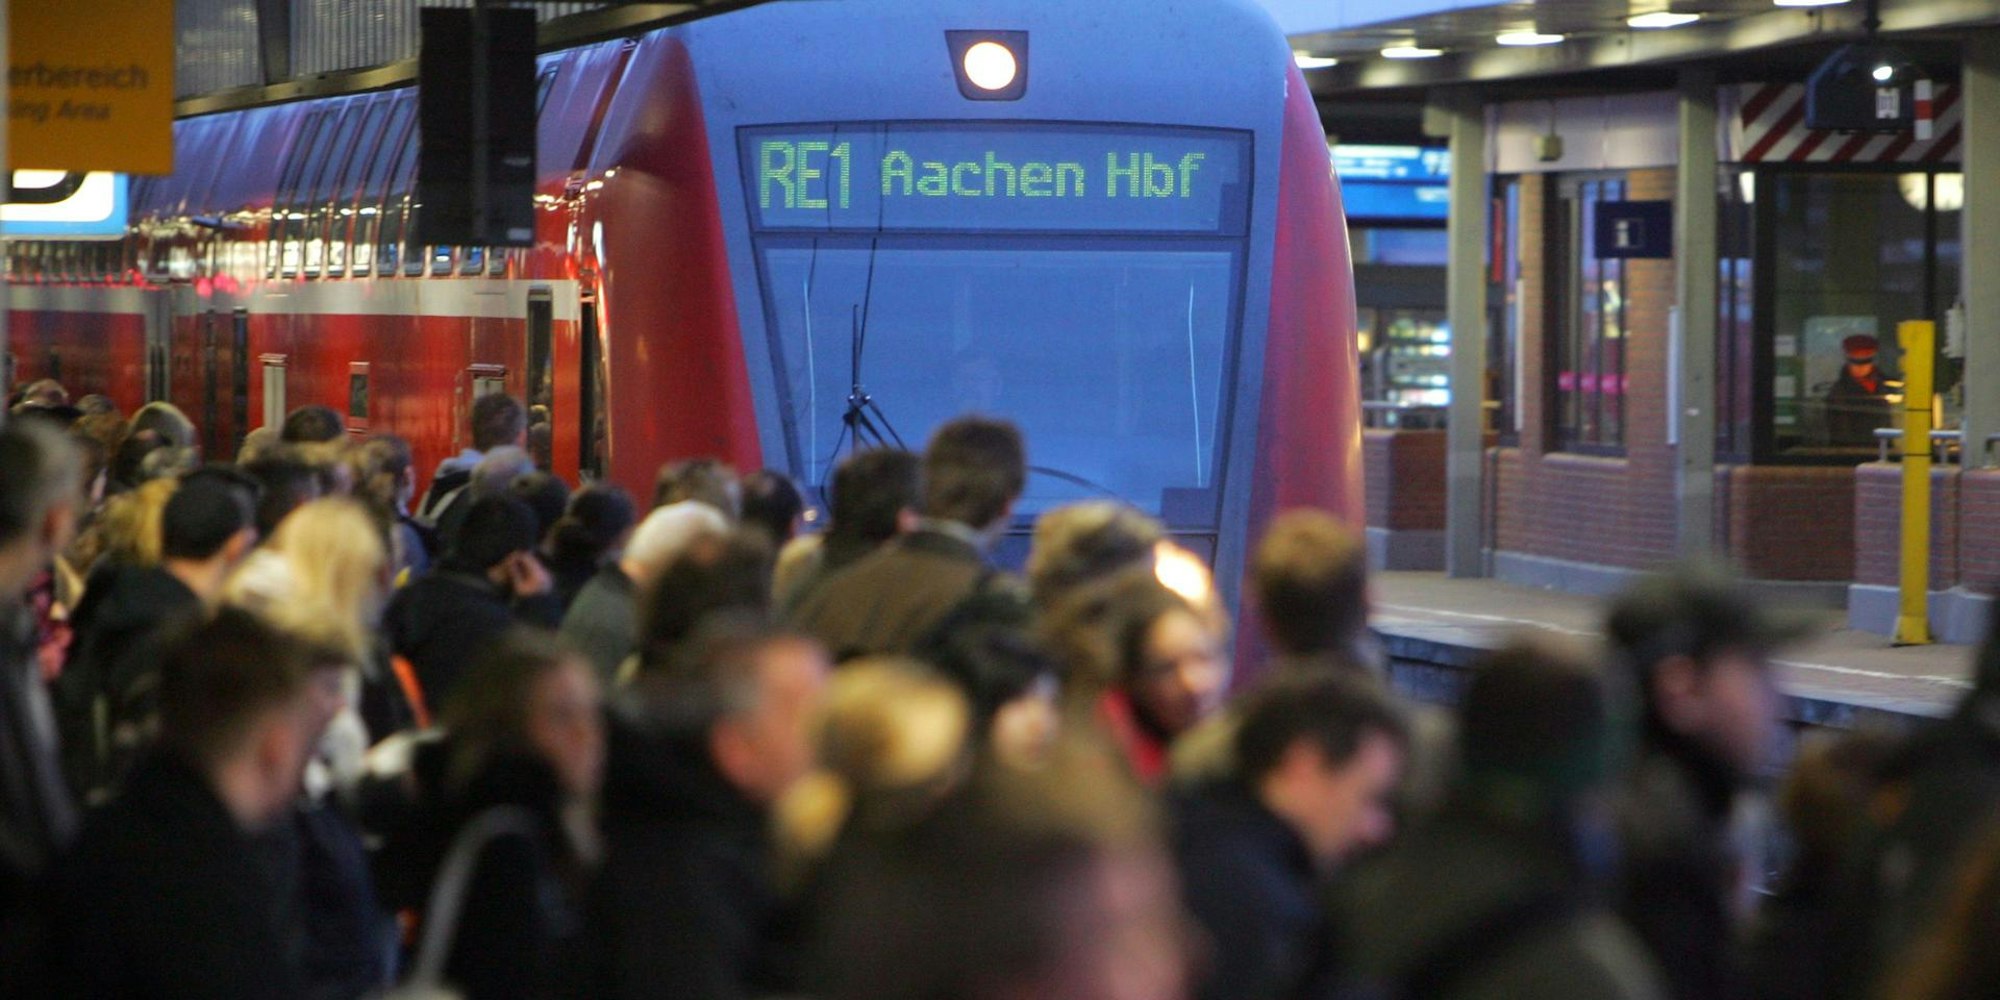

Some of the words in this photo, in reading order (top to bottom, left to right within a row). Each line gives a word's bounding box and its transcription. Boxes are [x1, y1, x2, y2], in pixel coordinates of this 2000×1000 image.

[761, 142, 849, 208] RE1
[882, 150, 1084, 196] Aachen
[1107, 152, 1204, 197] Hbf
